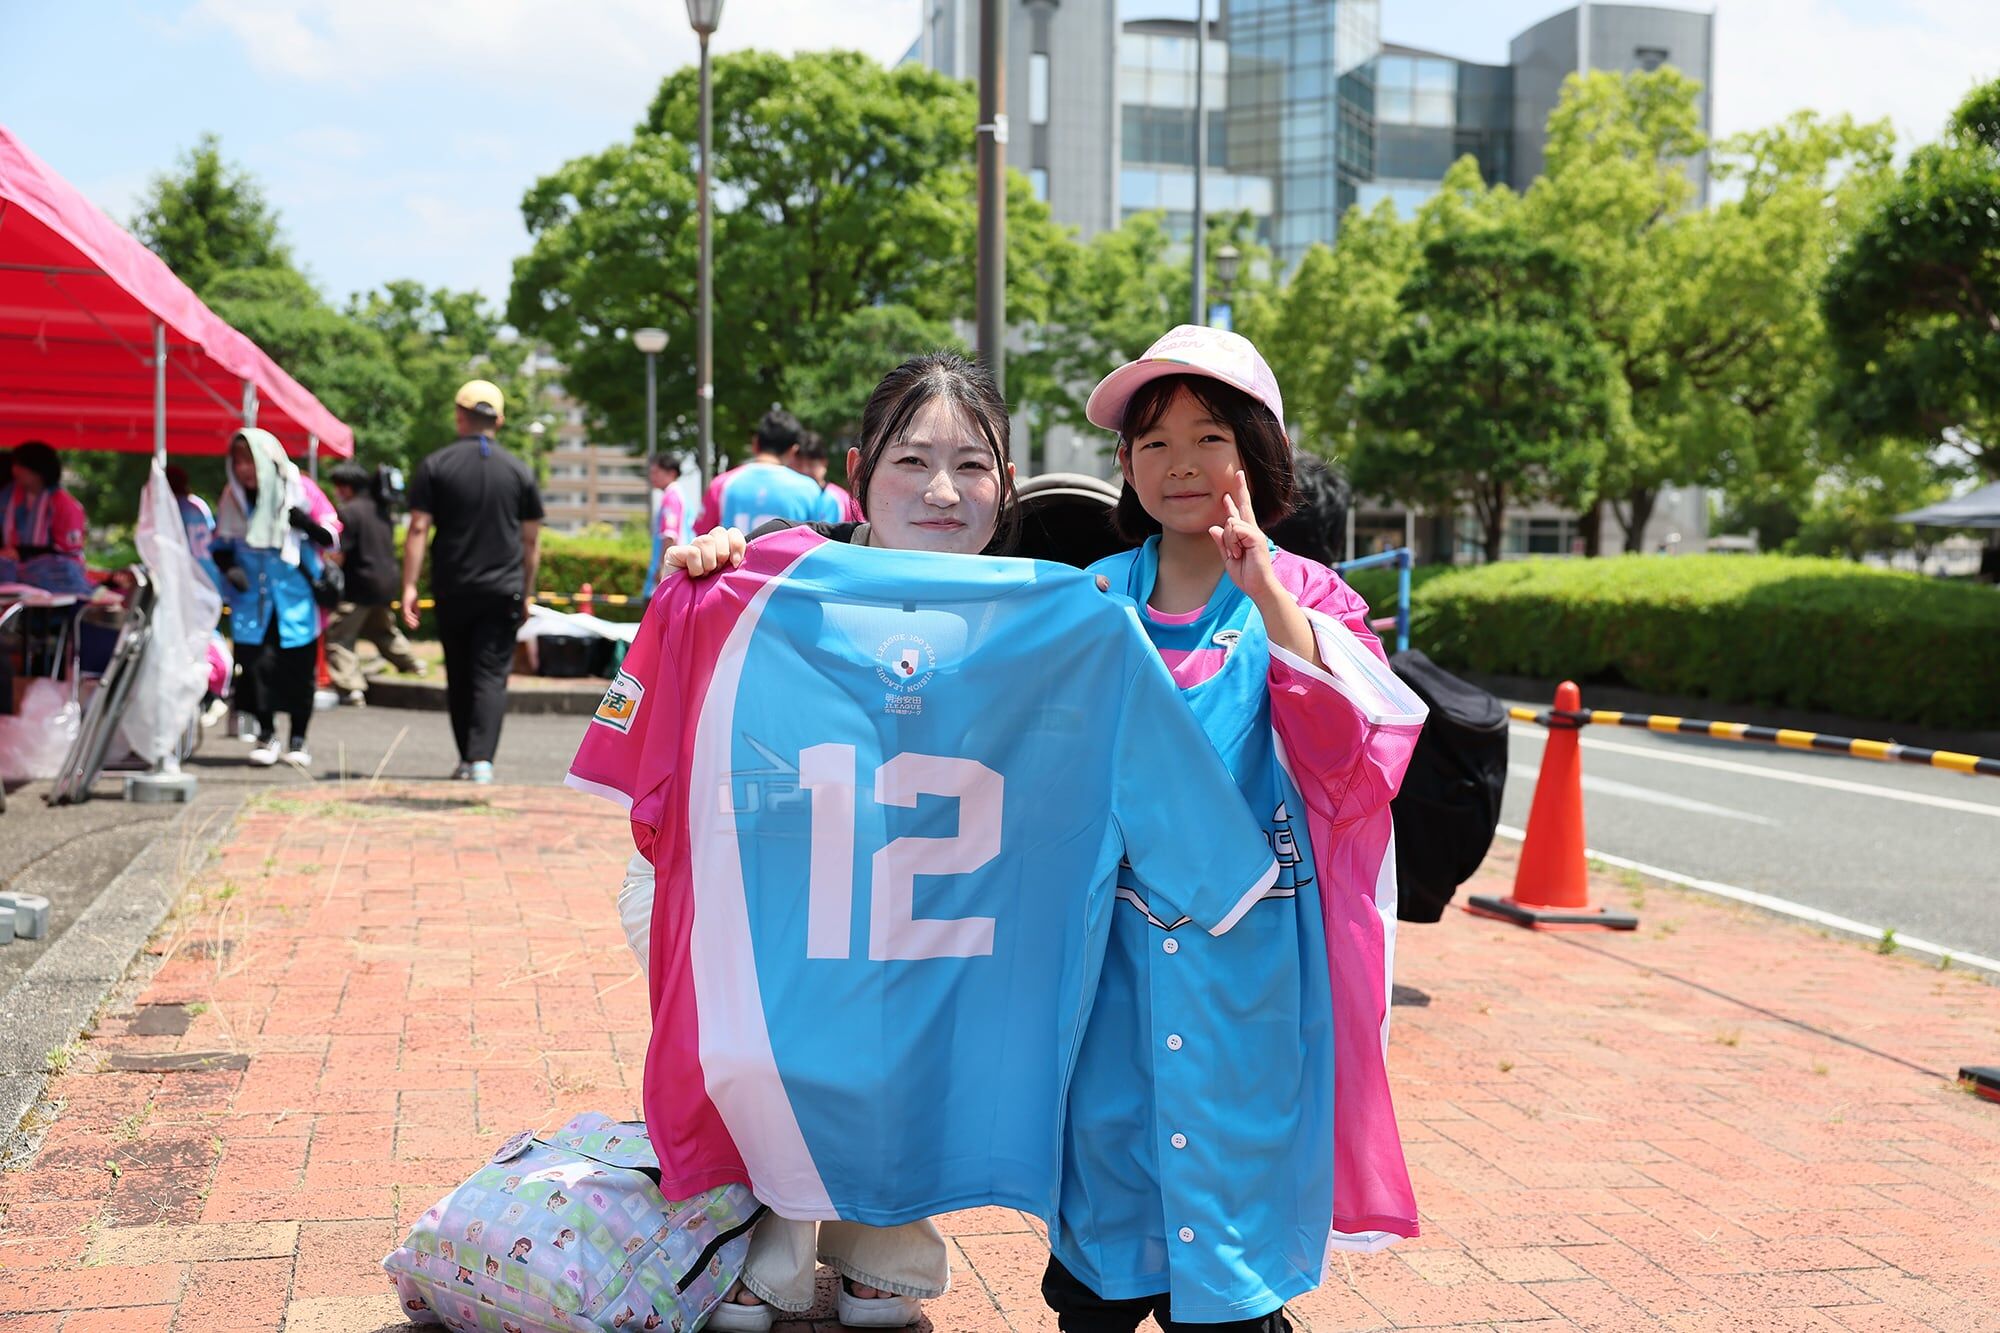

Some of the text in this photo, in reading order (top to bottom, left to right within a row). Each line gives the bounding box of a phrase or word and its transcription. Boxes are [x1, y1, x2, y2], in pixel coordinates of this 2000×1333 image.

[876, 666, 904, 692] LEAGUE
[907, 671, 933, 692] VISION
[885, 693, 921, 704] 明治安田
[799, 742, 1005, 961] 12
